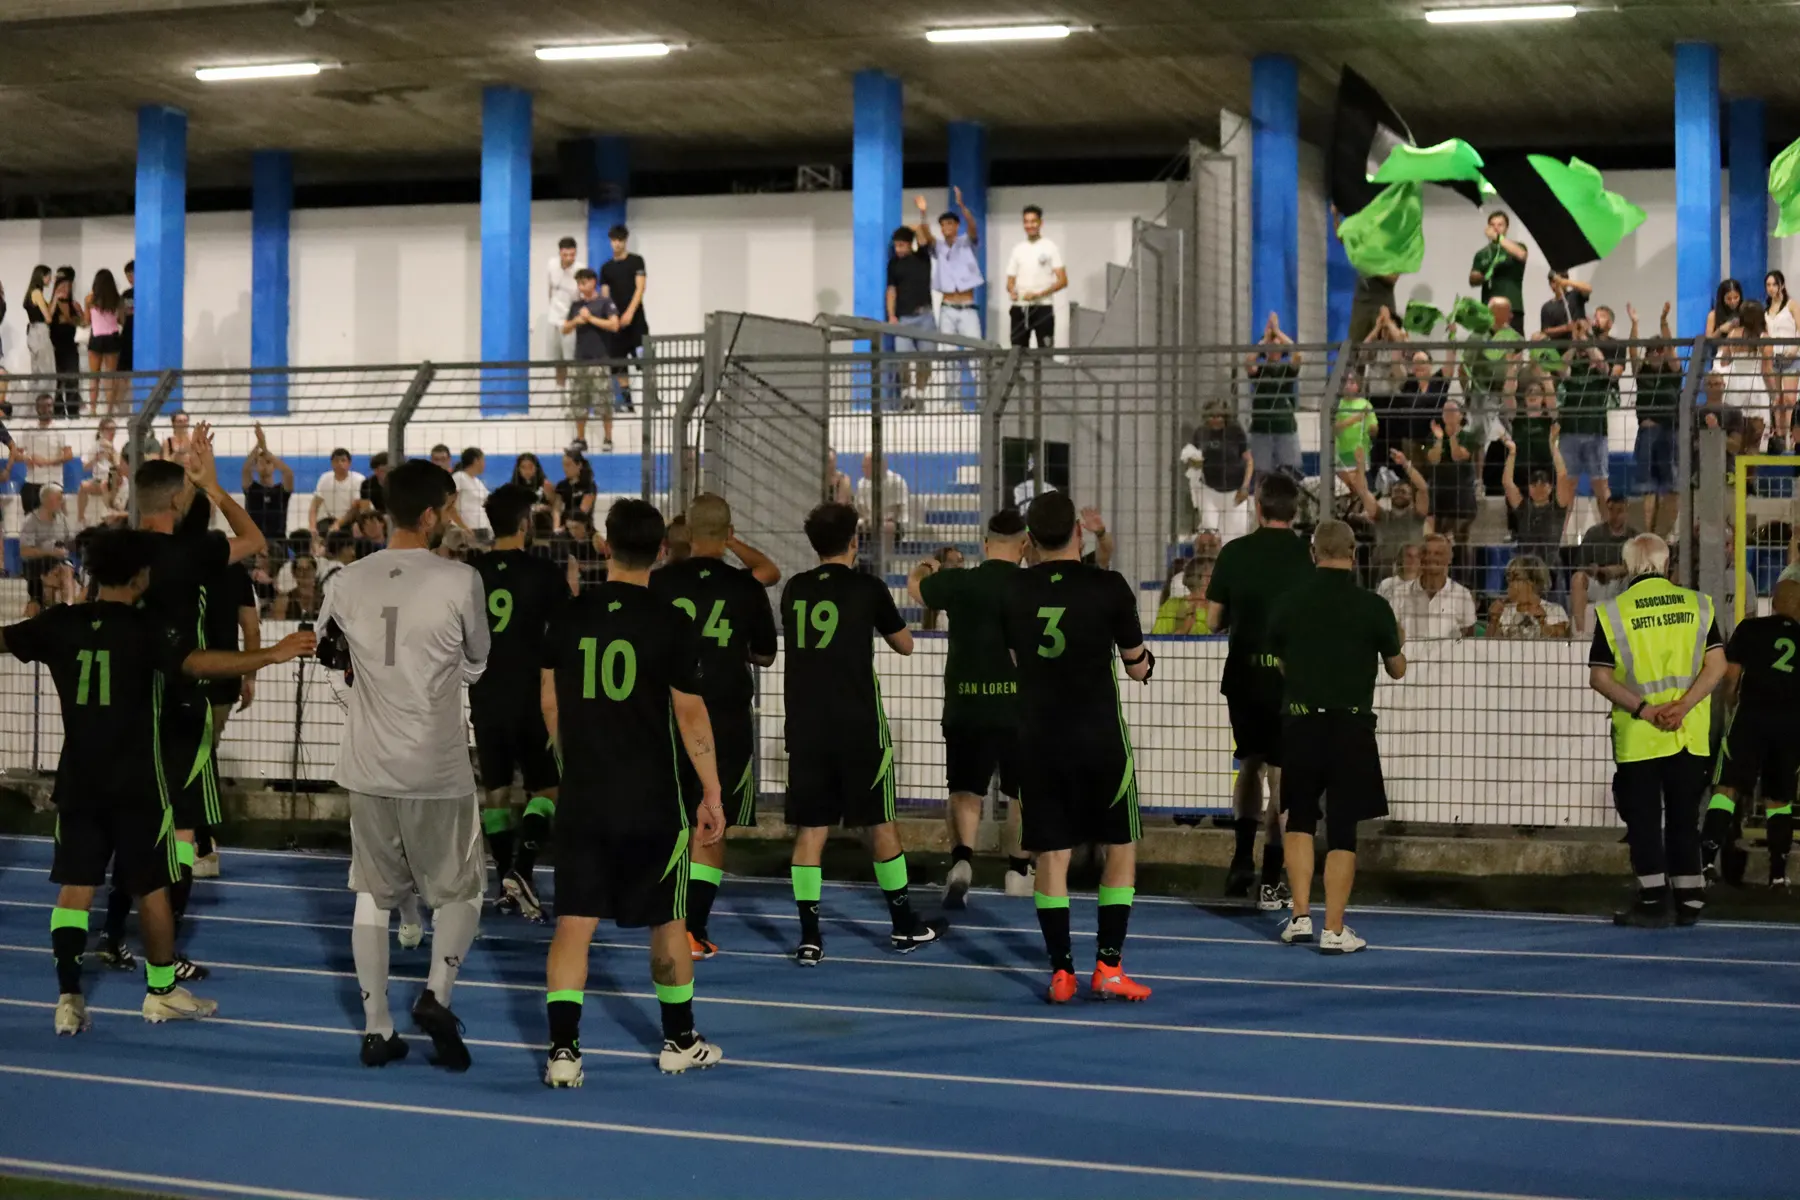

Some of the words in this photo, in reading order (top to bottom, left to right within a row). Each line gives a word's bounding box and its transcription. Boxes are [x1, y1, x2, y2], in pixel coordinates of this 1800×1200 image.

[488, 588, 513, 632] 9
[792, 599, 839, 649] 19
[1631, 615, 1655, 630] SAFETY
[1657, 617, 1663, 626] &
[1663, 611, 1695, 626] SECURITY
[1635, 594, 1685, 609] ASSOCIAZIONE
[380, 606, 398, 666] 1
[1036, 606, 1066, 658] 3
[1772, 637, 1796, 672] 2
[76, 649, 111, 706] 11
[578, 637, 637, 701] 10
[958, 682, 978, 695] SAN
